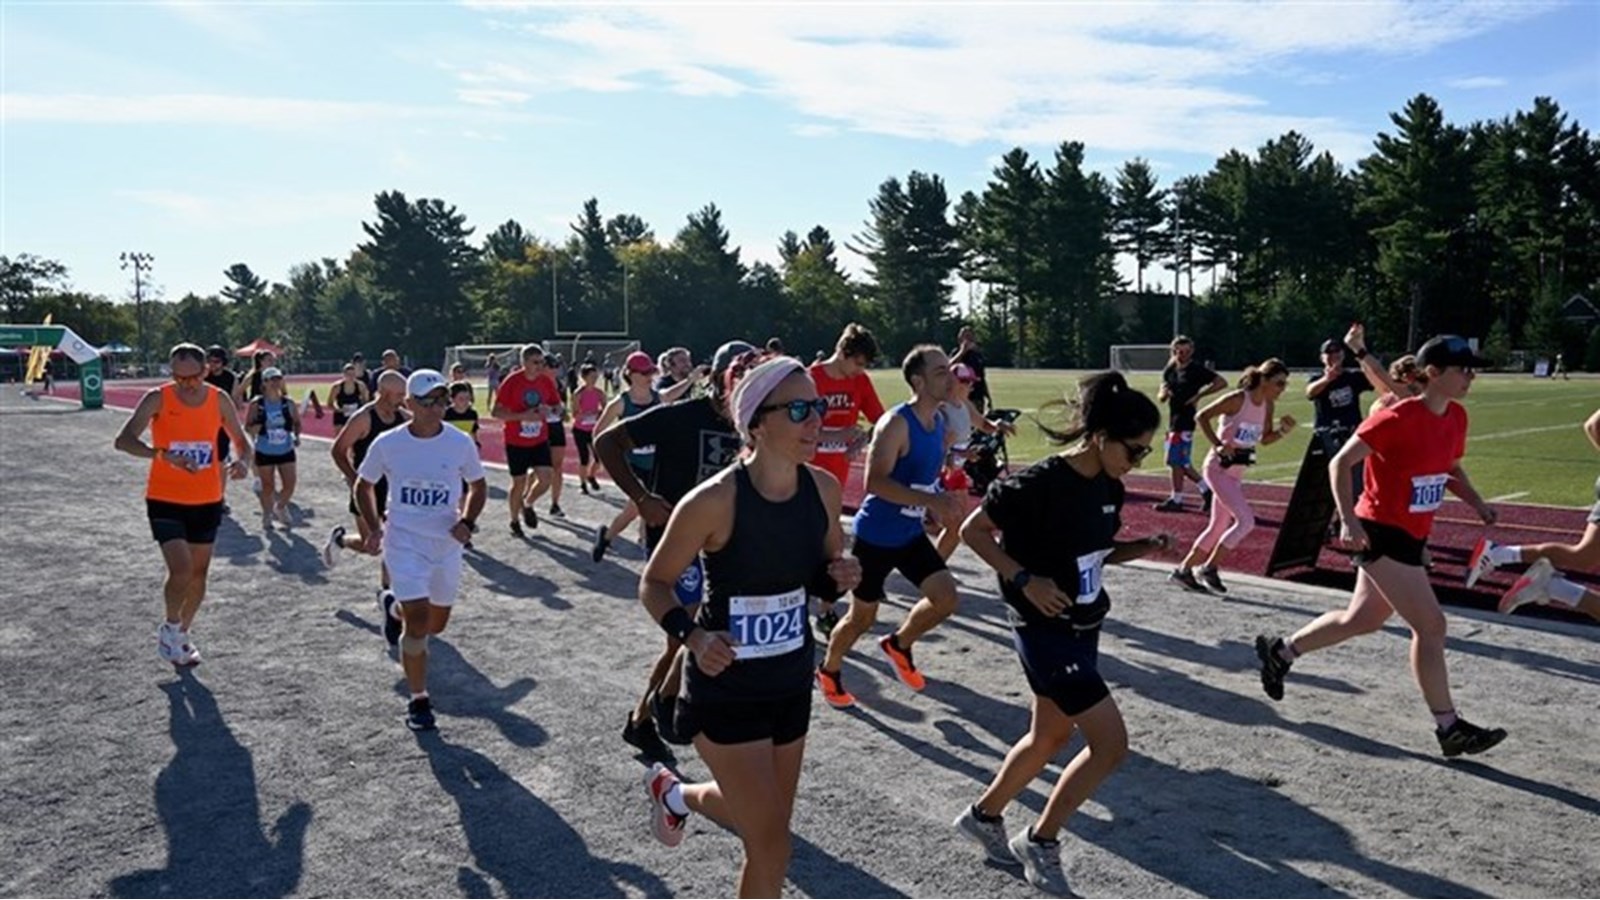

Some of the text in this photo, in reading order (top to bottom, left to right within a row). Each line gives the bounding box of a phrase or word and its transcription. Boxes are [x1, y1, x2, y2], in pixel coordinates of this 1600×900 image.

[403, 488, 449, 506] 1012
[1416, 484, 1443, 504] 1011
[736, 607, 803, 645] 1024
